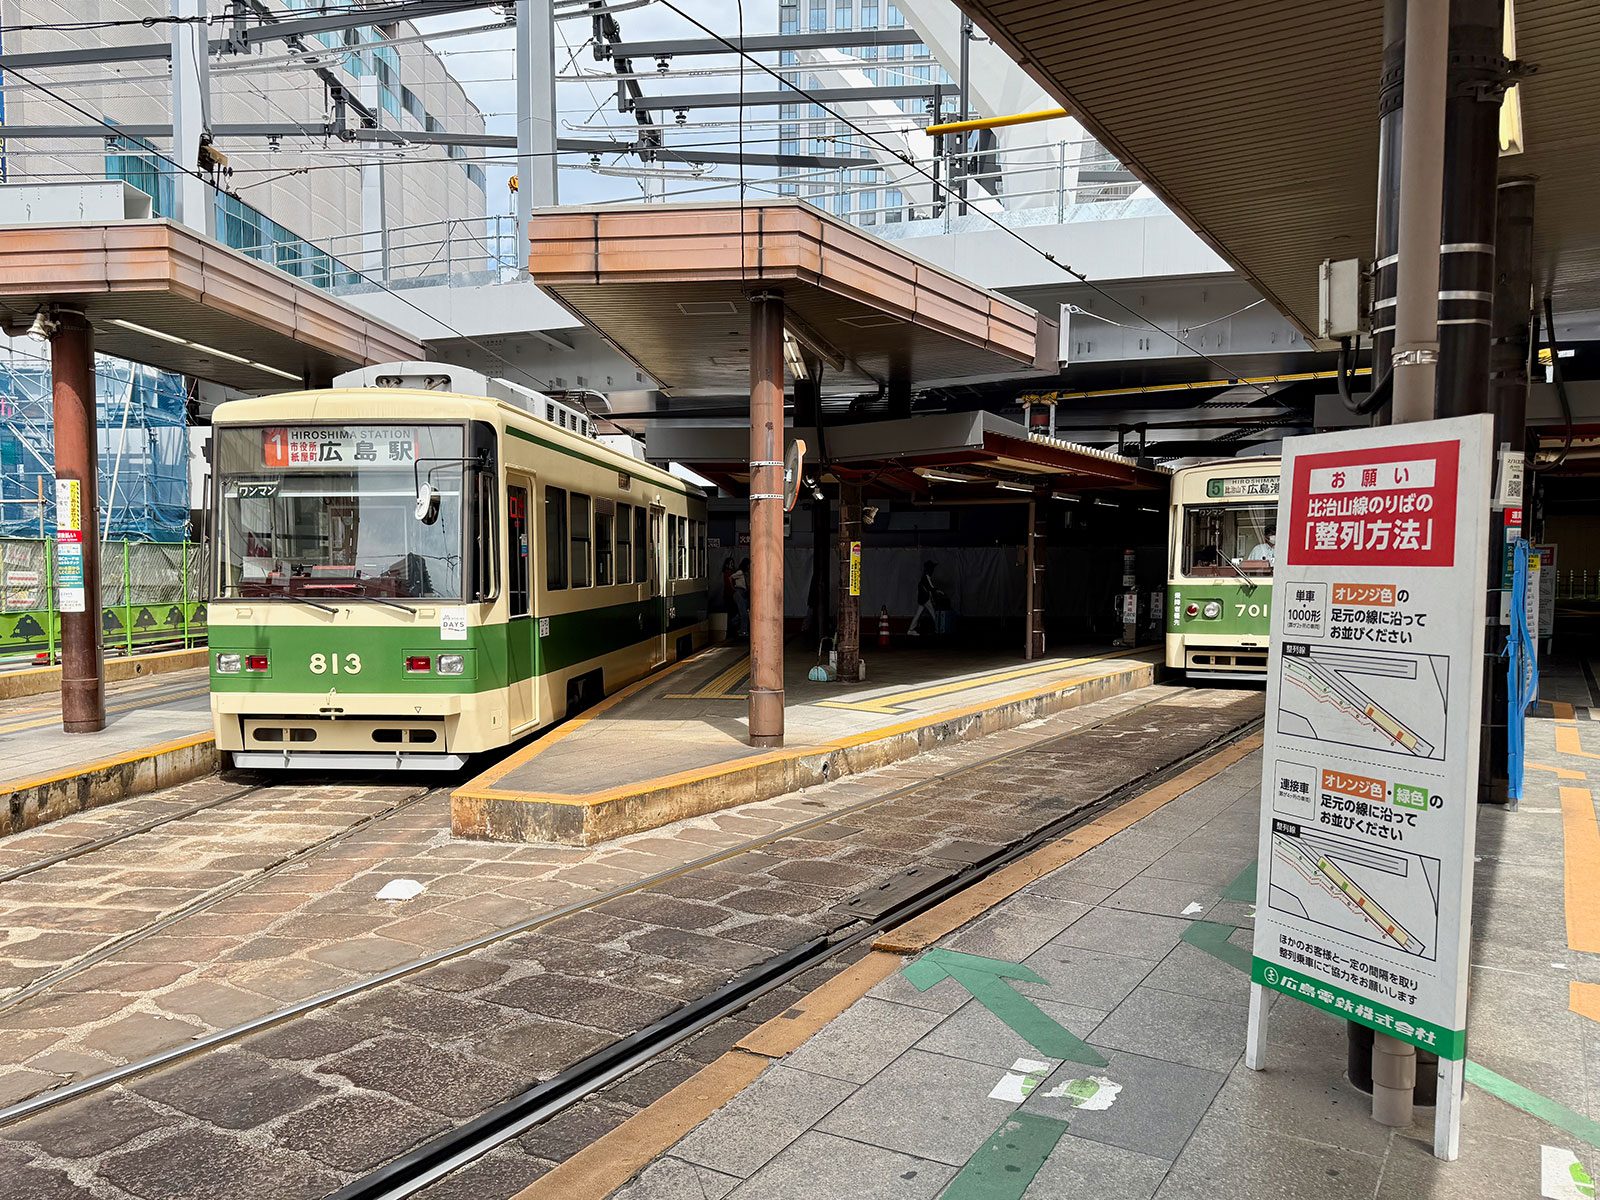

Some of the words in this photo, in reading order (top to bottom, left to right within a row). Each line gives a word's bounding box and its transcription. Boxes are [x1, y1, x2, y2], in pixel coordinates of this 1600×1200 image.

[291, 430, 356, 440] HIROSHIMA
[360, 429, 411, 439] STATION
[271, 433, 282, 461] 1
[290, 441, 317, 451] 市役所
[318, 440, 413, 462] 広島駅
[290, 452, 317, 463] 紙屋町
[1211, 480, 1220, 496] 5
[1331, 467, 1410, 489] お願い
[239, 486, 276, 498] ワンマン
[1307, 493, 1434, 518] 比治山線のりばの
[1305, 518, 1433, 551] 「整列方法」
[1295, 589, 1316, 603] 単車
[1235, 604, 1268, 617] 701
[1288, 609, 1321, 623] 1000形
[1330, 609, 1427, 627] 足元の線に沿って
[1330, 627, 1412, 644] お並びください
[309, 653, 362, 675] 813
[1279, 777, 1310, 795] 連接車
[1320, 793, 1418, 828] 足元の線に沿って
[1320, 811, 1403, 841] お並びください
[1279, 933, 1418, 991] ほかのお客様と一定の間隔を取り
[1279, 946, 1418, 1006] 整列乗車にご協力をお願いします
[1280, 976, 1436, 1047] 広島電鉄株式会社
